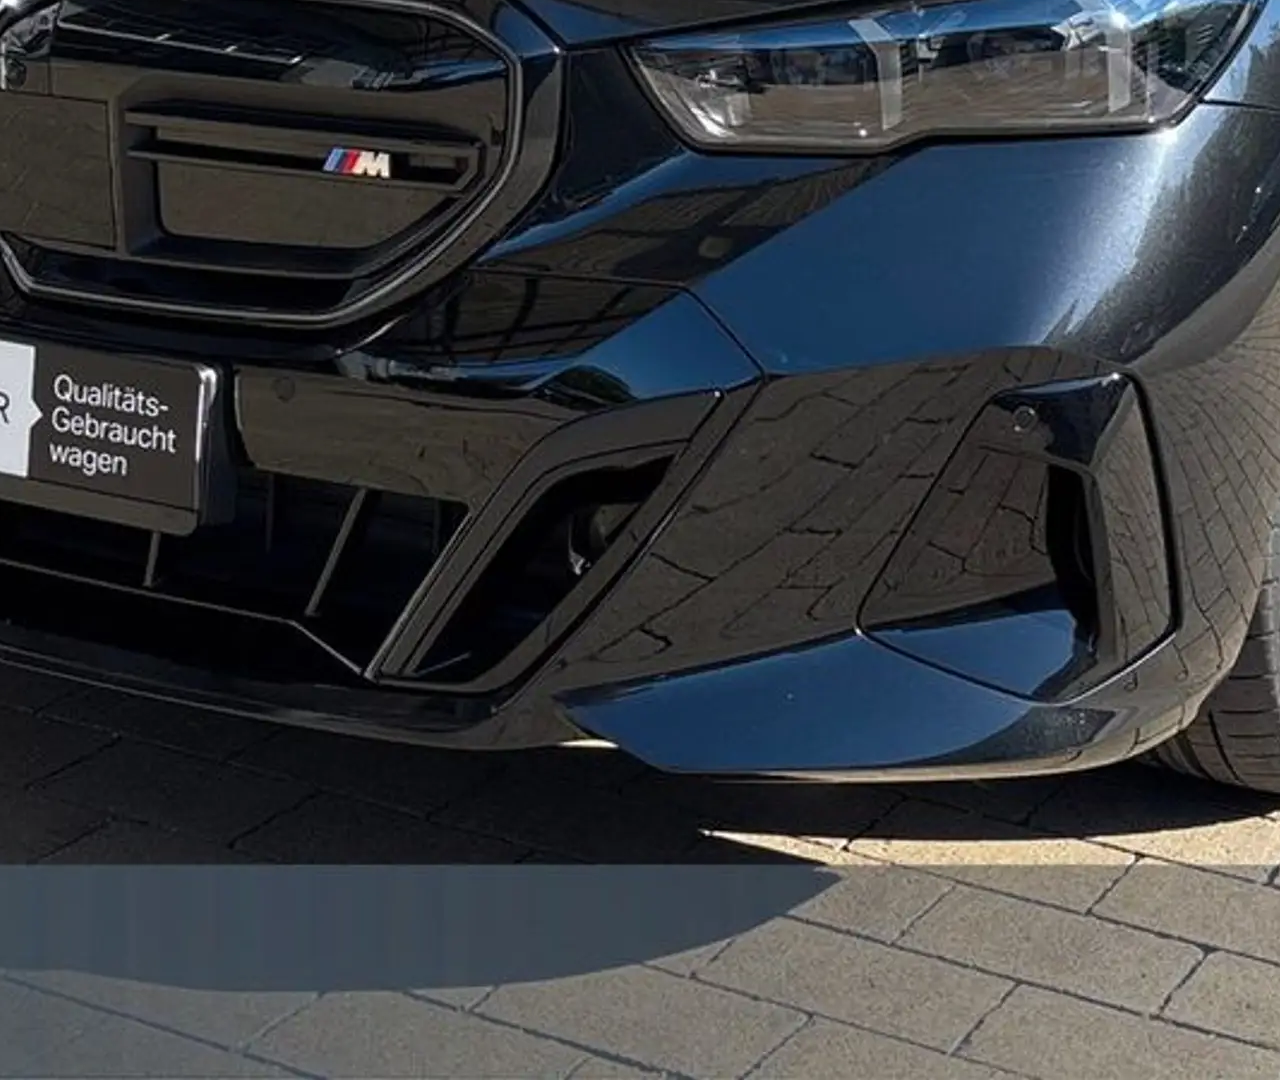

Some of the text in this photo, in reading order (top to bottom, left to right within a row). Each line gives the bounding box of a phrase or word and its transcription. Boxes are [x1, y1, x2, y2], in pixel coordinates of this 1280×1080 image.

[53, 374, 169, 417] Qualitäts-
[51, 406, 176, 453] Gebraucht
[49, 442, 128, 476] wagen
